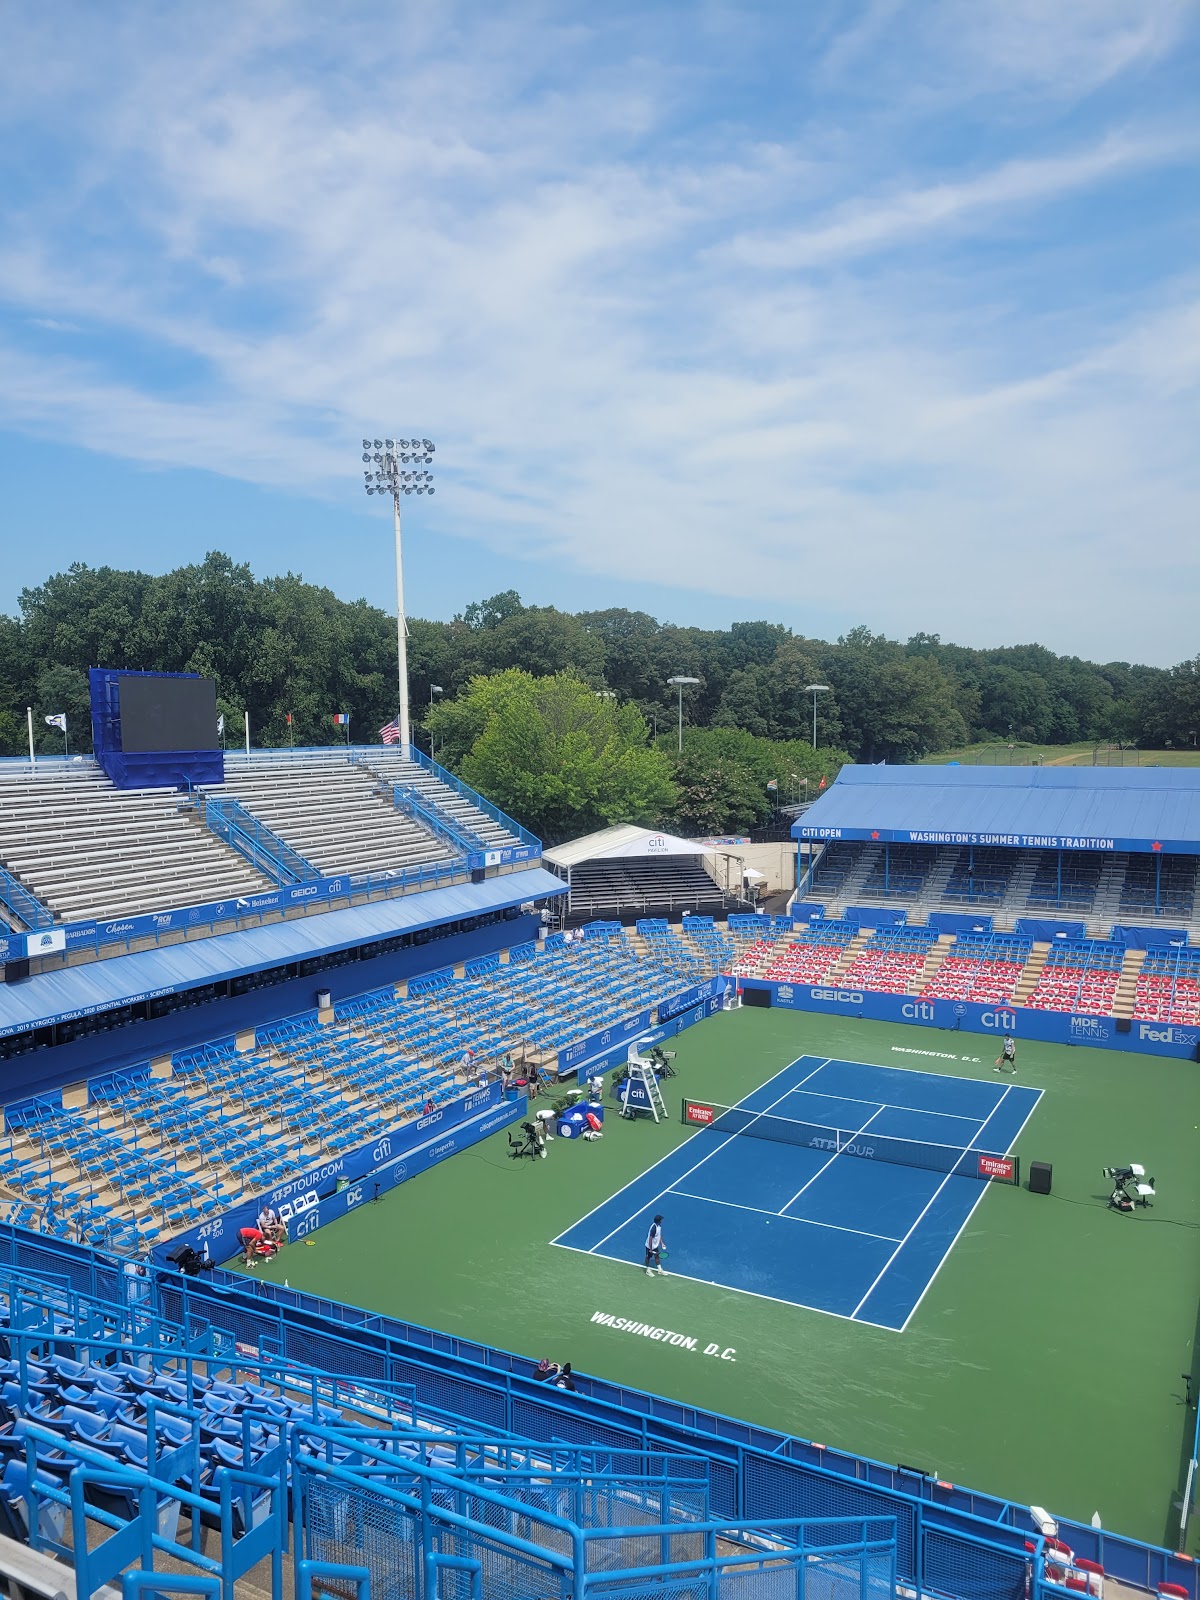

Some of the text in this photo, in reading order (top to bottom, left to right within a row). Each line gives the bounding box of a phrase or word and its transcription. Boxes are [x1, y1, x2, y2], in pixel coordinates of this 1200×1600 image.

[648, 836, 665, 847] citi
[802, 828, 841, 838] CITI OPEN
[909, 832, 1114, 849] WASHINGTON'S SUMMER TENNIS TRADITION
[290, 886, 318, 898] GEICO
[329, 880, 341, 893] citi
[65, 927, 96, 939] BARBADOS
[106, 923, 134, 934] Chosen
[810, 989, 864, 1004] GEICO
[16, 1024, 29, 1032] 2019
[31, 1017, 56, 1028] KYRGIOS
[96, 1000, 121, 1011] ESSENTIAL
[122, 994, 145, 1005] WORKERS
[150, 987, 175, 998] SCIENTISTS
[901, 997, 935, 1021] citi
[623, 1017, 640, 1031] GEICO
[981, 1006, 1017, 1030] citi
[601, 1031, 611, 1045] citi
[1139, 1024, 1197, 1046] FedEx
[586, 1059, 609, 1077] #CITIOPEN
[631, 1088, 645, 1099] citi
[480, 1107, 517, 1133] citiopentennis.com
[689, 1106, 713, 1117] Emirates
[416, 1110, 443, 1131] GEICO
[373, 1137, 391, 1161] citi
[838, 1141, 875, 1158] TOUR
[981, 1159, 1012, 1171] Emirates
[347, 1187, 363, 1207] DC
[196, 1219, 223, 1240] ATP
[297, 1208, 320, 1236] citi
[212, 1229, 224, 1239] 500
[590, 1311, 737, 1362] WASHINGTON, D.C.
